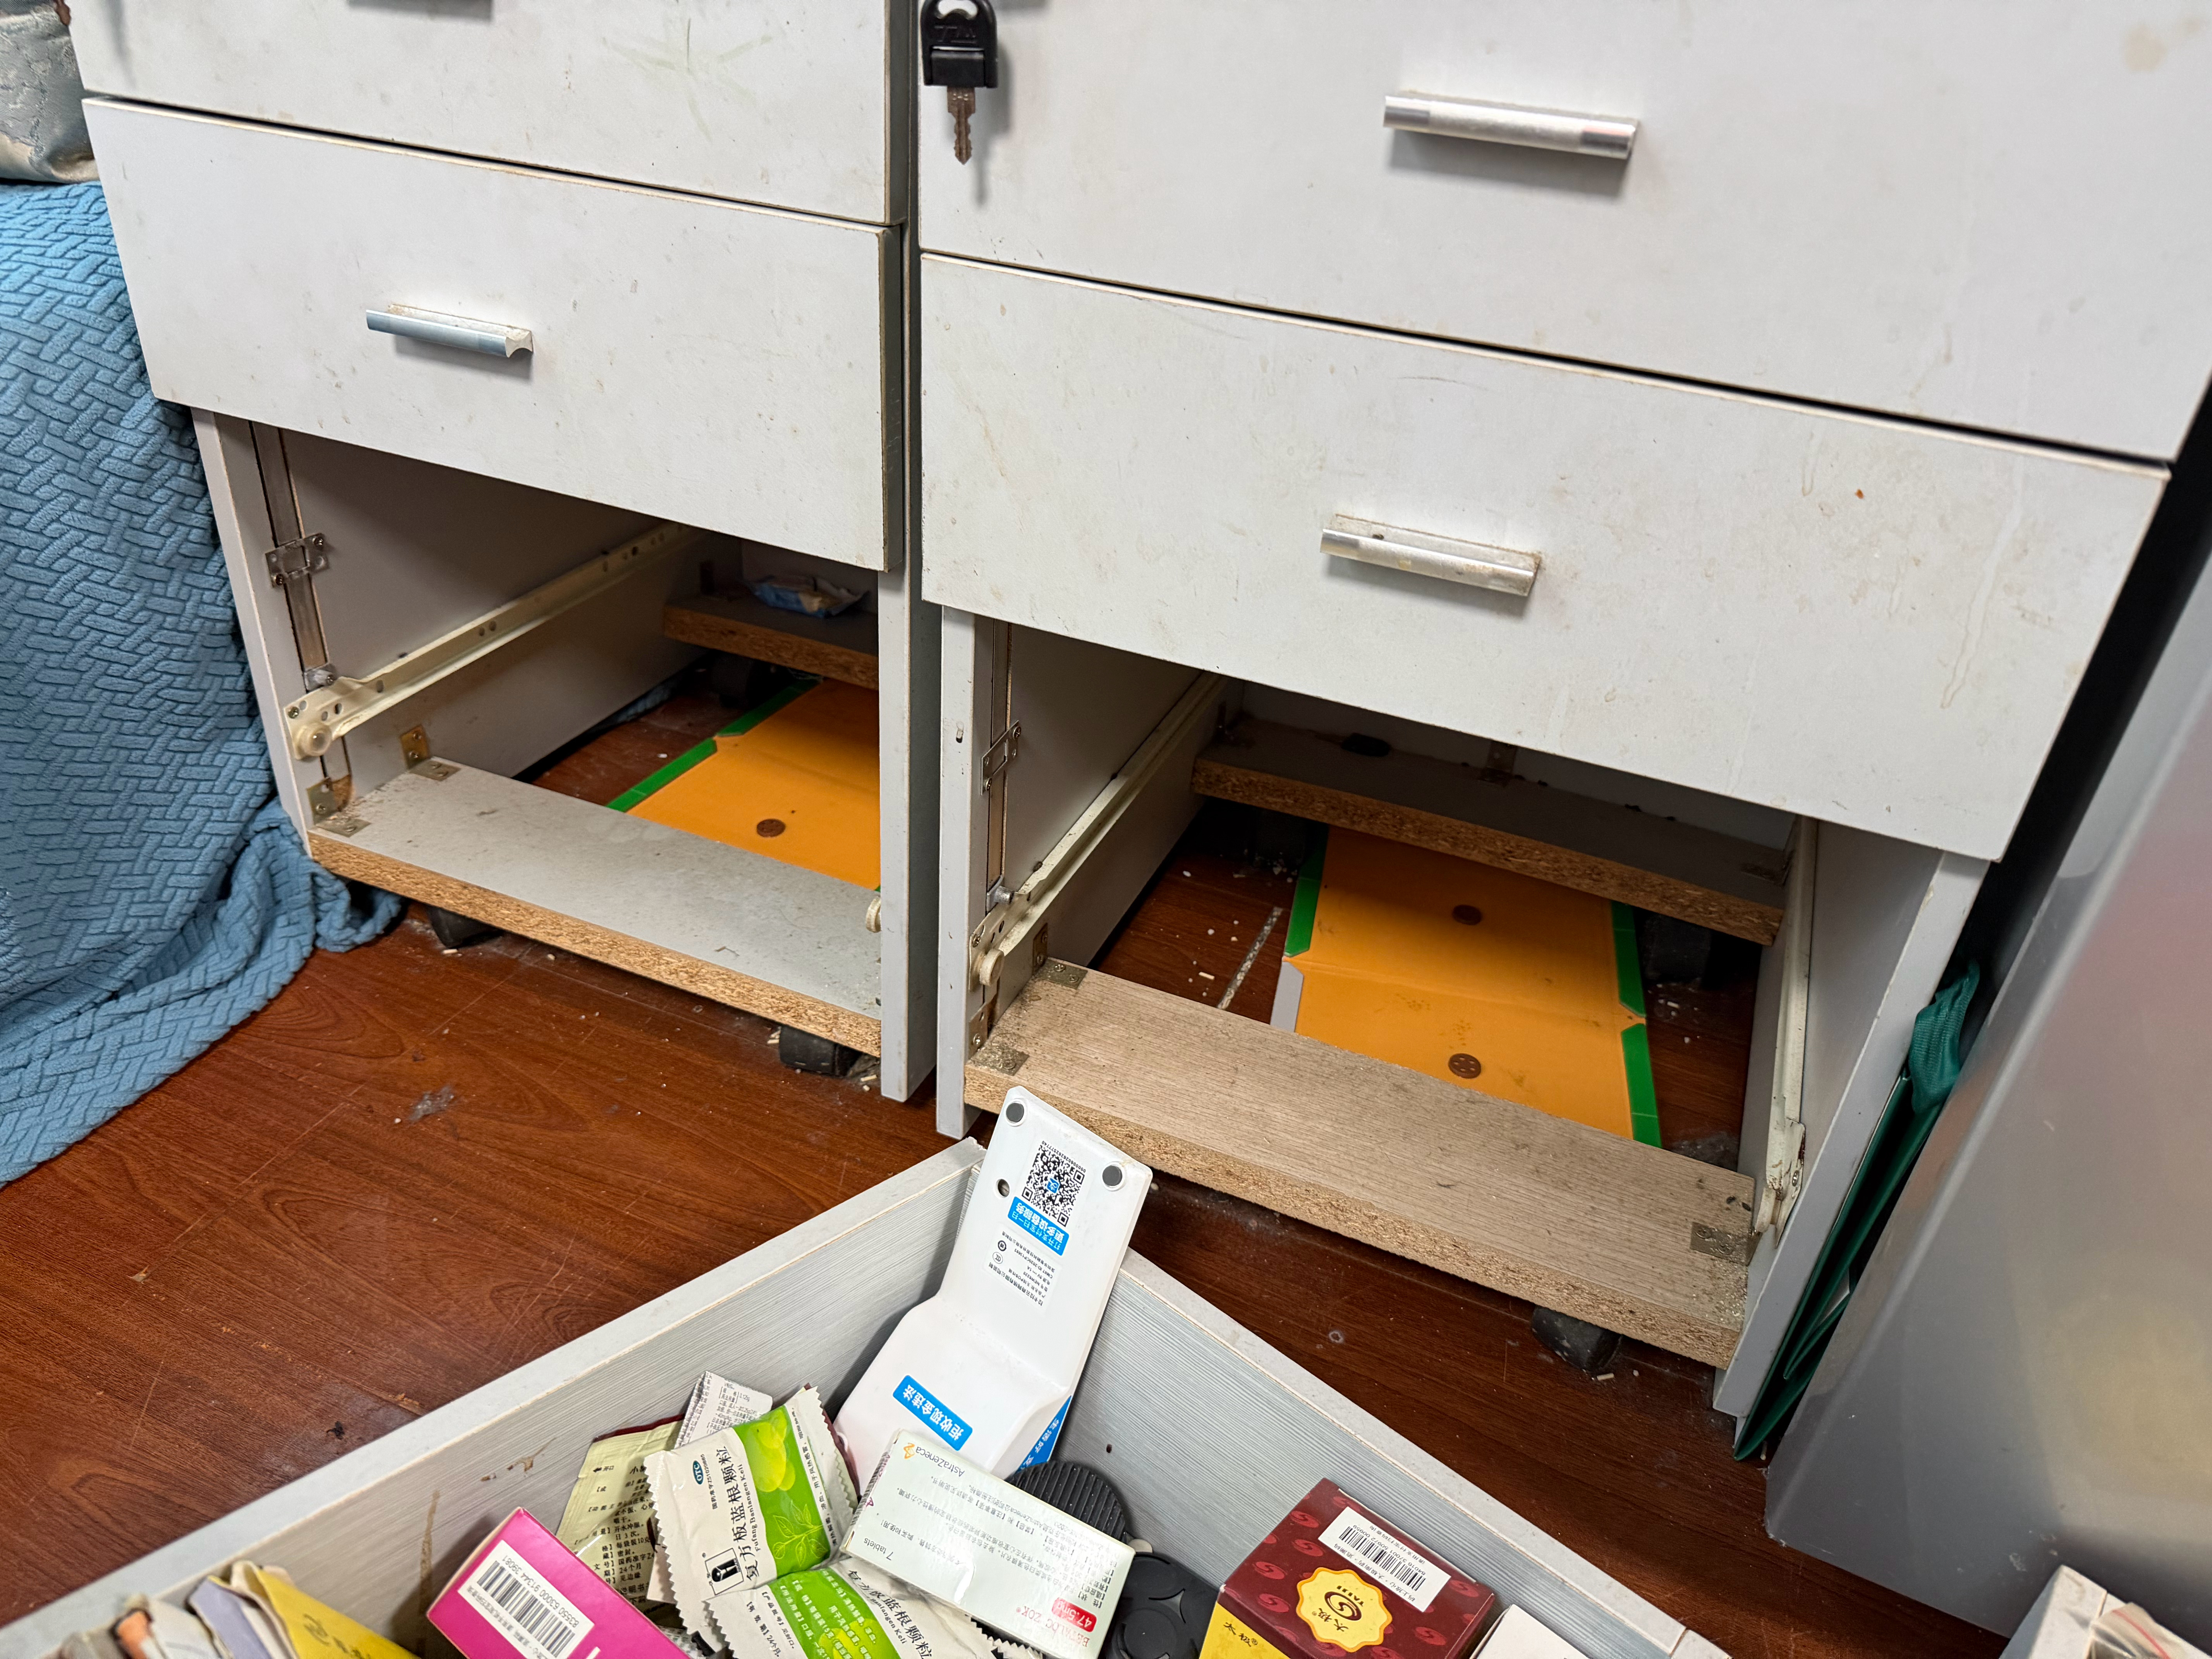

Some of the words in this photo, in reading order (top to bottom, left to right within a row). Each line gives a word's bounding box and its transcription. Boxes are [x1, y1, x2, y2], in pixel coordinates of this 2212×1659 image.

[1011, 1210, 1061, 1251] 打开支付宝扫一扫
[1014, 1201, 1065, 1243] 更多设备服务
[901, 1384, 964, 1443] 拒收现金违法
[693, 1462, 703, 1481] OTC
[737, 1464, 746, 1480] Keli
[915, 1445, 965, 1478] AstraZeneca
[714, 1445, 761, 1580] 复方板蓝根颗粒
[742, 1482, 756, 1523] Banlangen
[750, 1524, 761, 1551] Fufang
[862, 1537, 887, 1554] tablets
[501, 1554, 522, 1575] 39081
[886, 1550, 894, 1561] 7
[1389, 1549, 1407, 1563] 37001
[519, 1571, 541, 1592] 91344
[538, 1589, 560, 1611] 63000
[1336, 1585, 1364, 1607] TAIJI
[557, 1606, 580, 1628] 83550
[761, 1591, 784, 1626] 【产品批号】
[1054, 1599, 1093, 1630] 47.5mg
[894, 1628, 908, 1645] Keli
